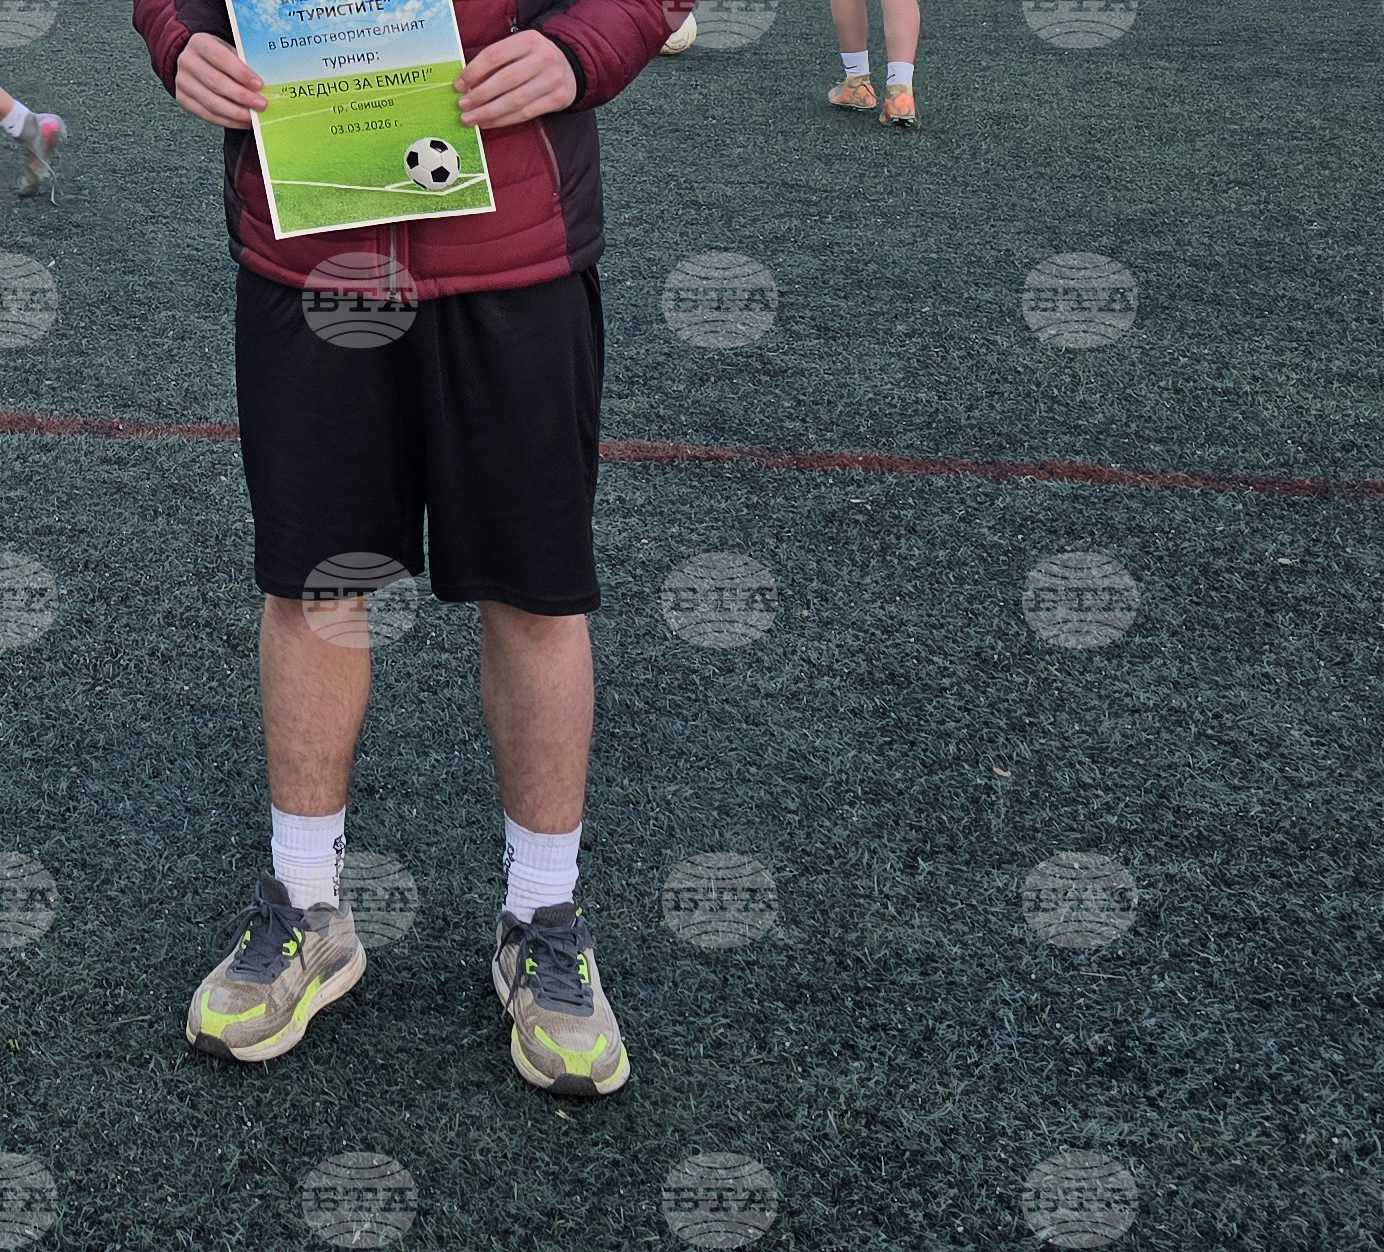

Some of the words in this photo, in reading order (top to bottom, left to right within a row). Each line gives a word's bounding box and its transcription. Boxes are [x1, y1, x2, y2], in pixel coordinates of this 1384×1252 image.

[268, 40, 277, 51] в
[279, 18, 426, 49] Благотворителният
[322, 50, 380, 69] турнир:
[353, 77, 373, 91] ЗА
[332, 104, 348, 114] гр.
[350, 98, 395, 112] Свищов
[330, 118, 392, 136] 03.03.2026
